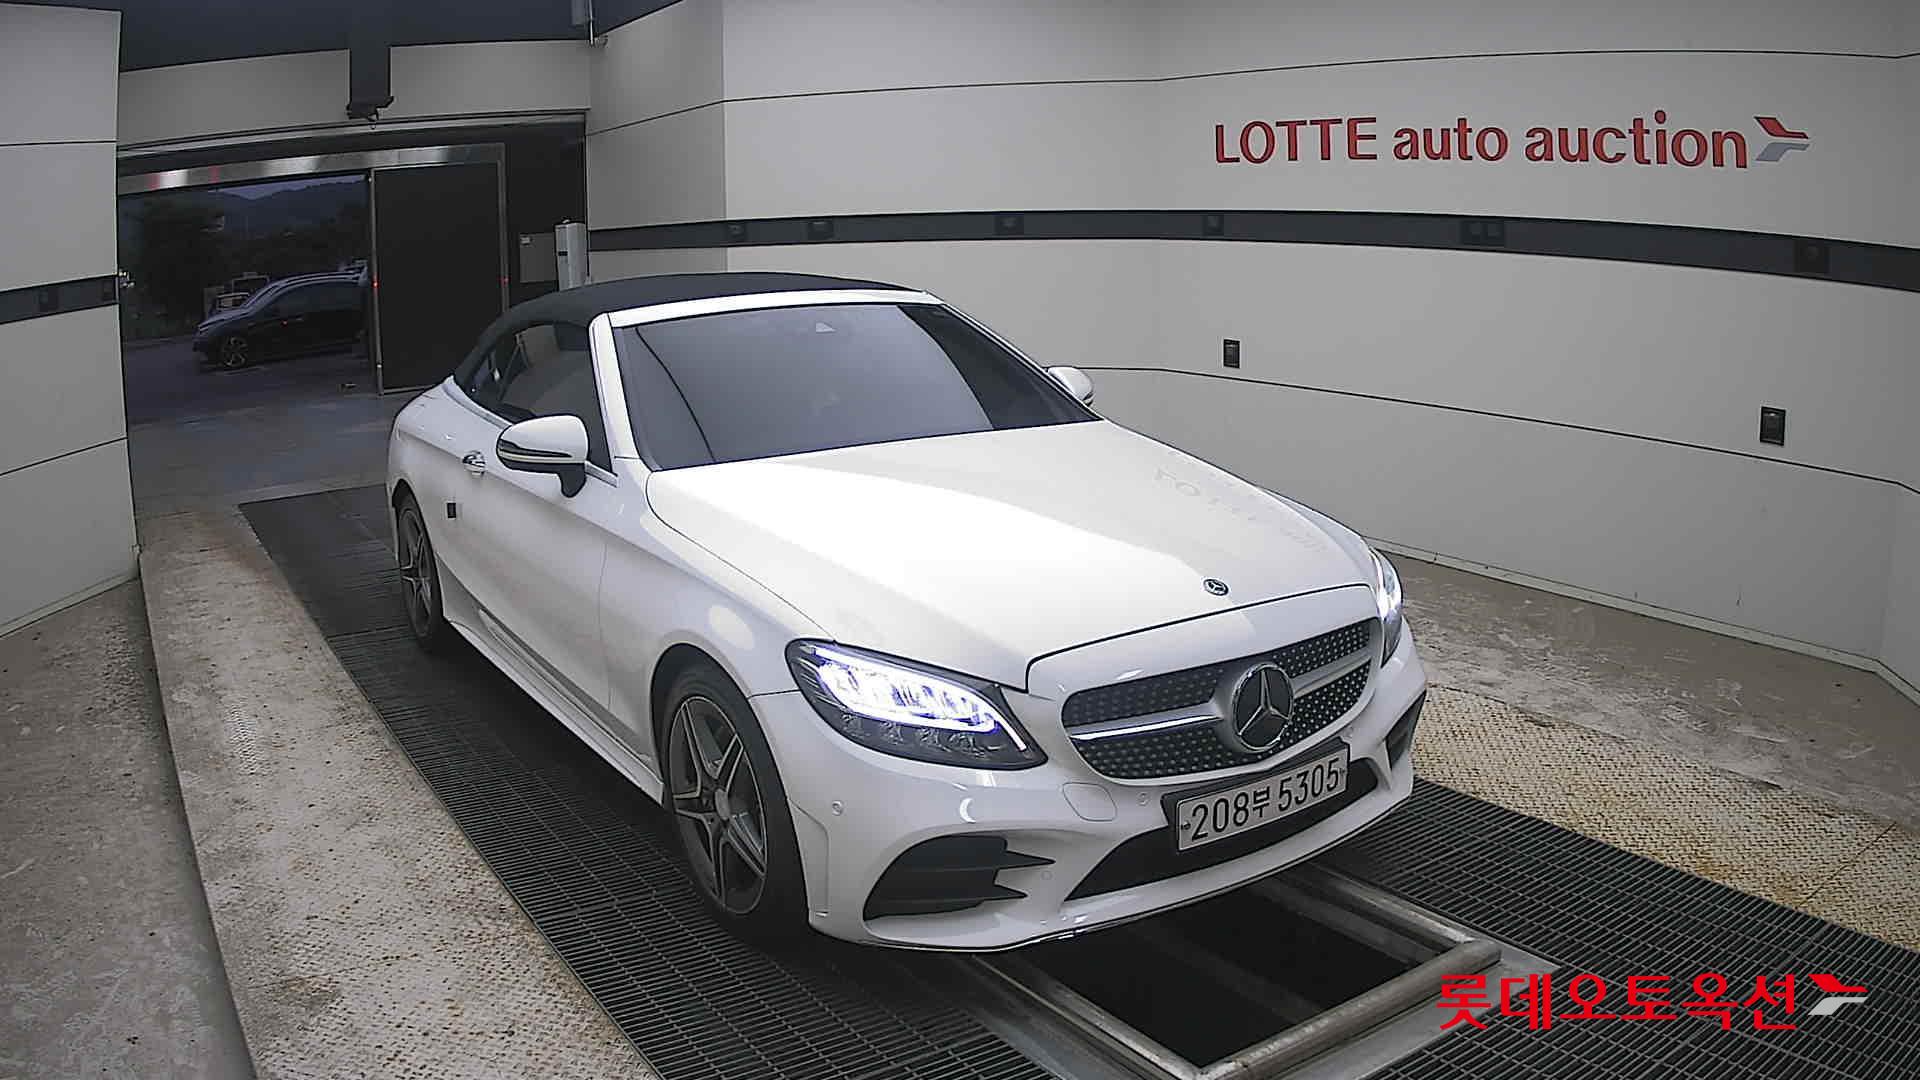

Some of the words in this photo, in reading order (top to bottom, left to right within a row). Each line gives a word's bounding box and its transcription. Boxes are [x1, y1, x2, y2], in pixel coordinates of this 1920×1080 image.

[1215, 116, 1377, 163] LOTTE
[1392, 117, 1508, 161] auto
[1524, 110, 1748, 169] auction
[1191, 786, 1270, 841] 208부
[1278, 757, 1340, 812] 5305
